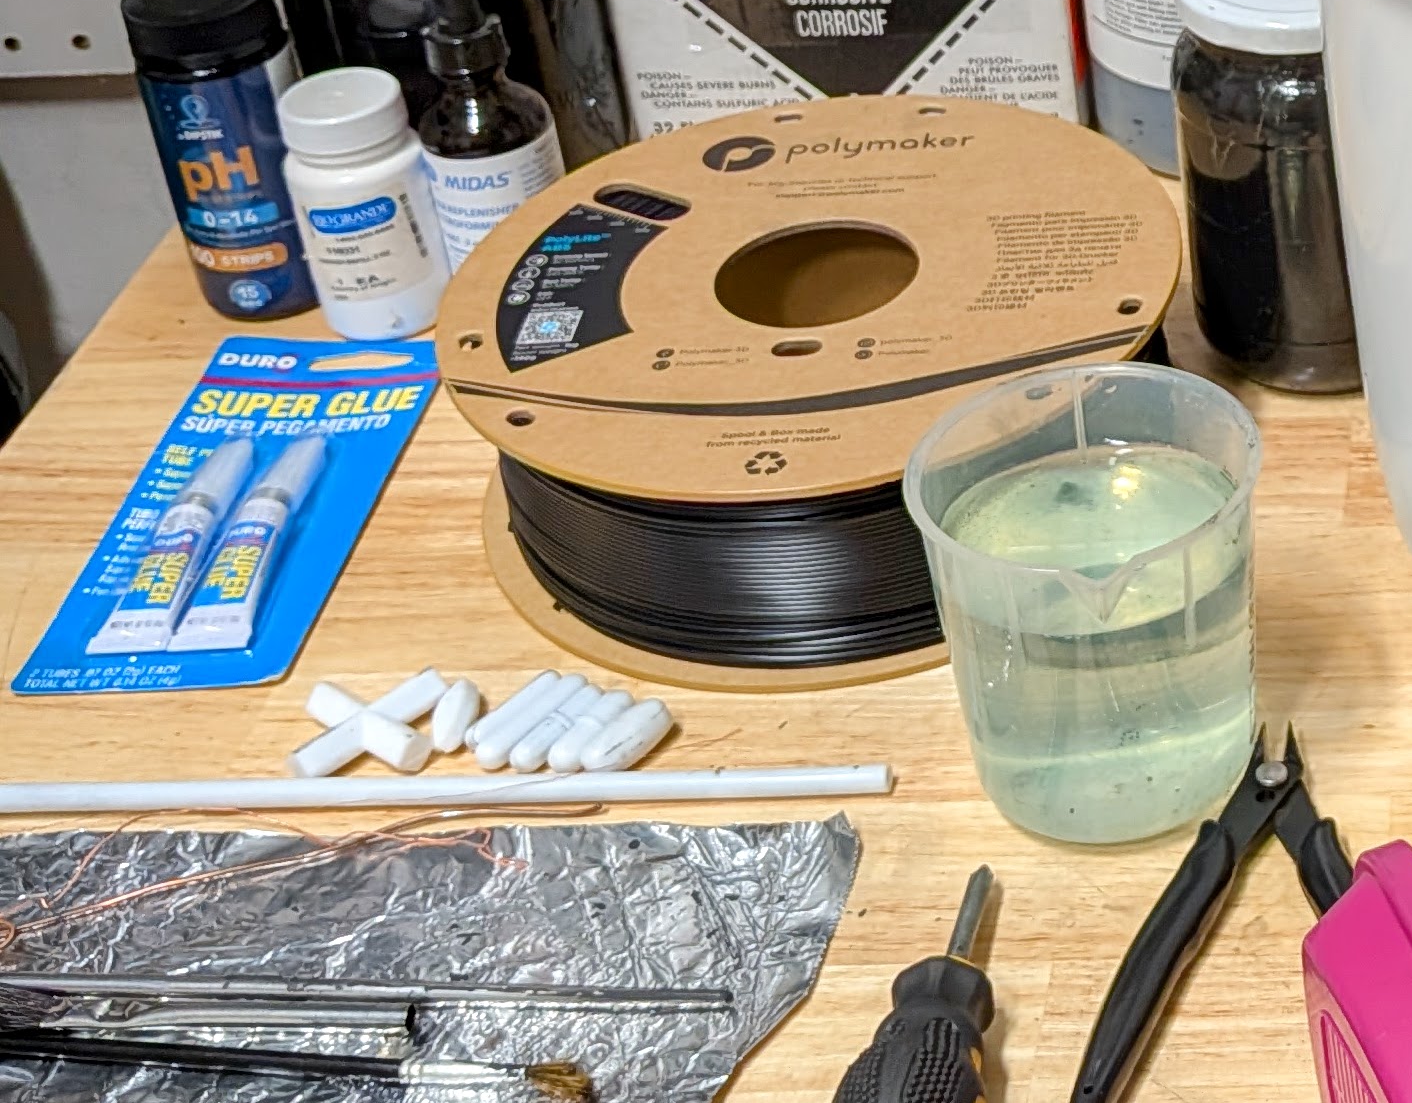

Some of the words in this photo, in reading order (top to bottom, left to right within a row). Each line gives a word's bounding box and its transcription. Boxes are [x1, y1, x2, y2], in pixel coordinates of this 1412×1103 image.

[796, 9, 888, 36] CORROSIF
[650, 81, 693, 90] CAUSES
[697, 81, 734, 89] SEVERE
[739, 80, 776, 89] BURNS
[1017, 74, 1060, 83] GRAVES
[654, 99, 712, 108] CONTAINS
[785, 132, 974, 163] polymaker
[178, 145, 259, 202] pH
[445, 173, 510, 191] MIDAS
[202, 209, 258, 227] 0-14
[221, 250, 274, 267] STRIPS
[219, 353, 298, 370] DURO
[192, 389, 321, 418] SUPER
[326, 386, 424, 416] GLUE
[705, 440, 735, 448] from
[738, 437, 789, 446] recycled
[792, 434, 841, 443] material
[721, 430, 755, 440] Spool
[796, 426, 831, 434] made
[145, 552, 189, 604] SUPER
[221, 545, 263, 599] SUPER
[147, 665, 181, 675] EACH
